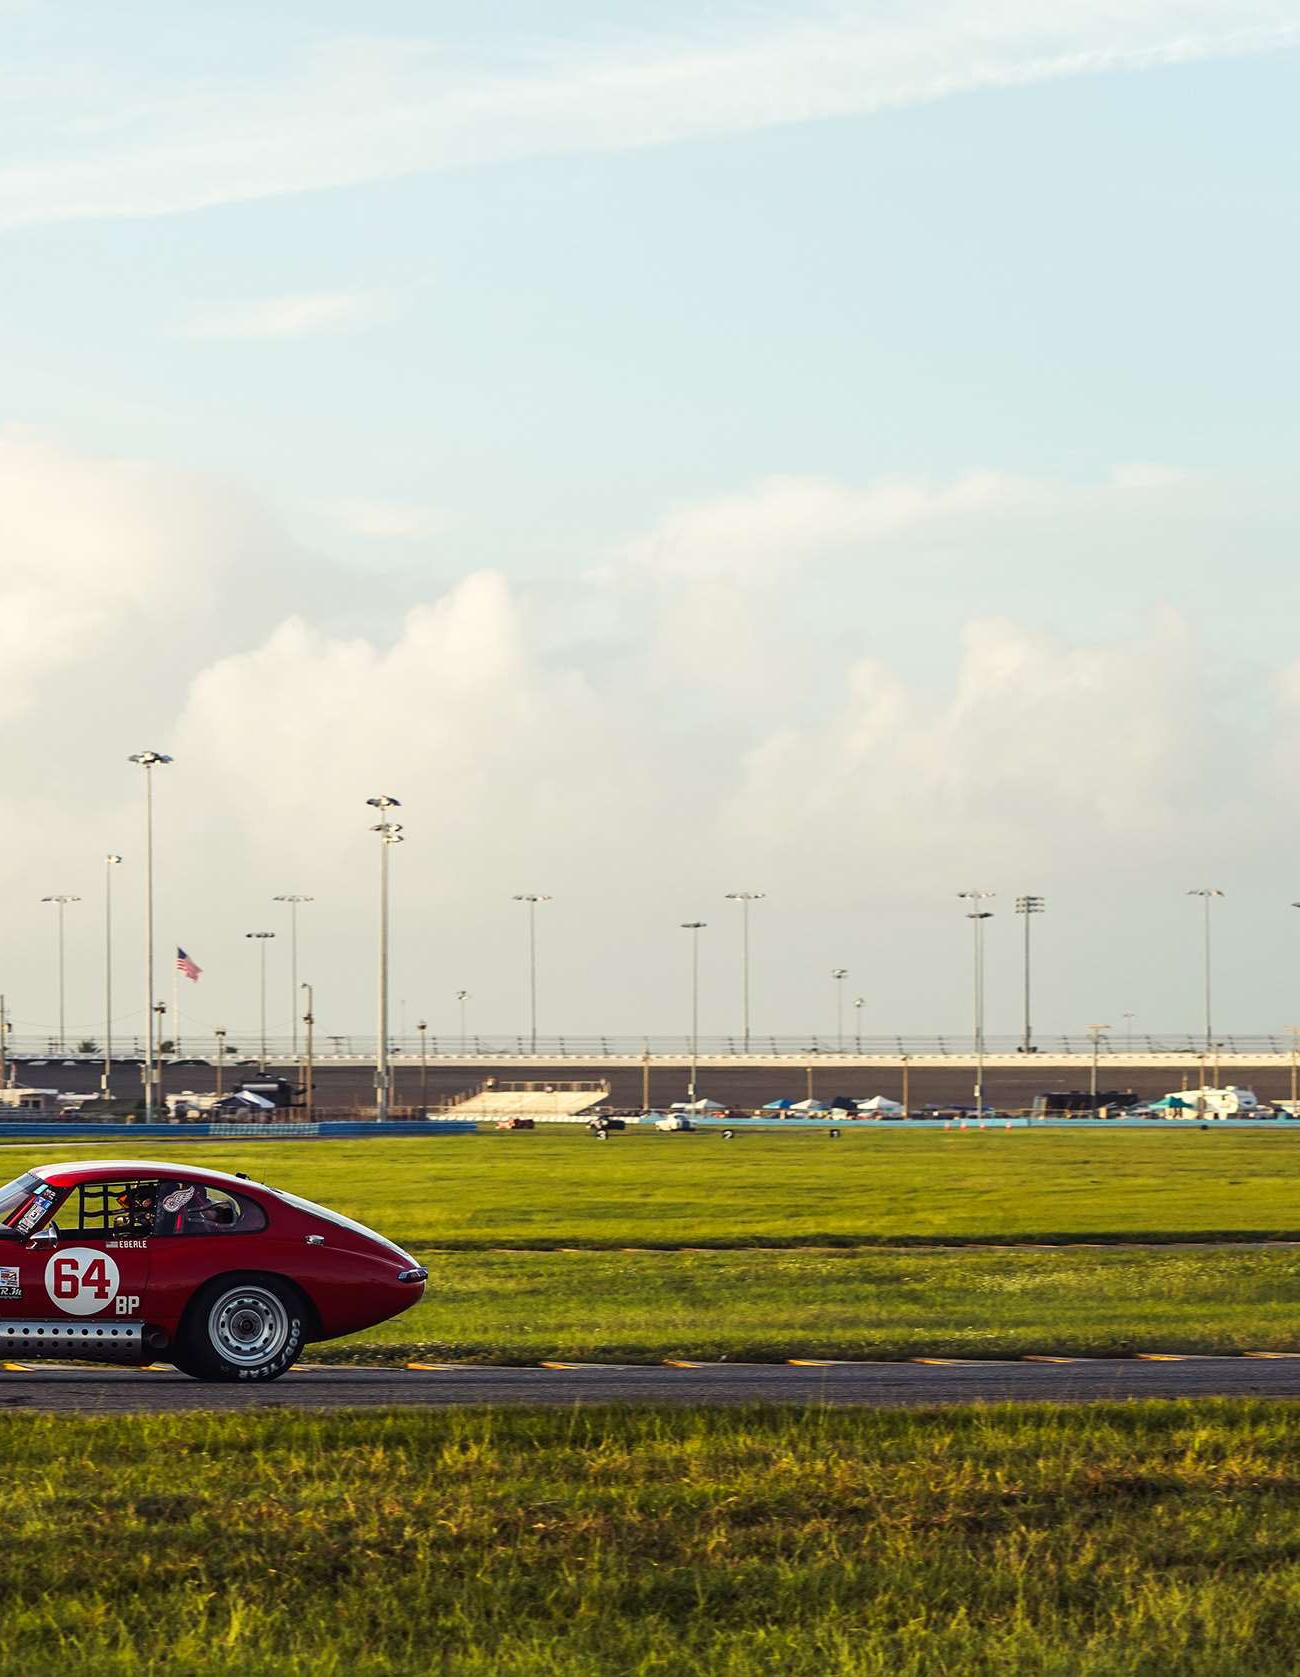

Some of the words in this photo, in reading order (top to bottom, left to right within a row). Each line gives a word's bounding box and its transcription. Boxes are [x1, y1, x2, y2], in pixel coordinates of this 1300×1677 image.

[597, 1130, 606, 1140] 3
[119, 1240, 148, 1249] EBERLE
[53, 1258, 111, 1300] 64
[115, 1295, 140, 1315] BP
